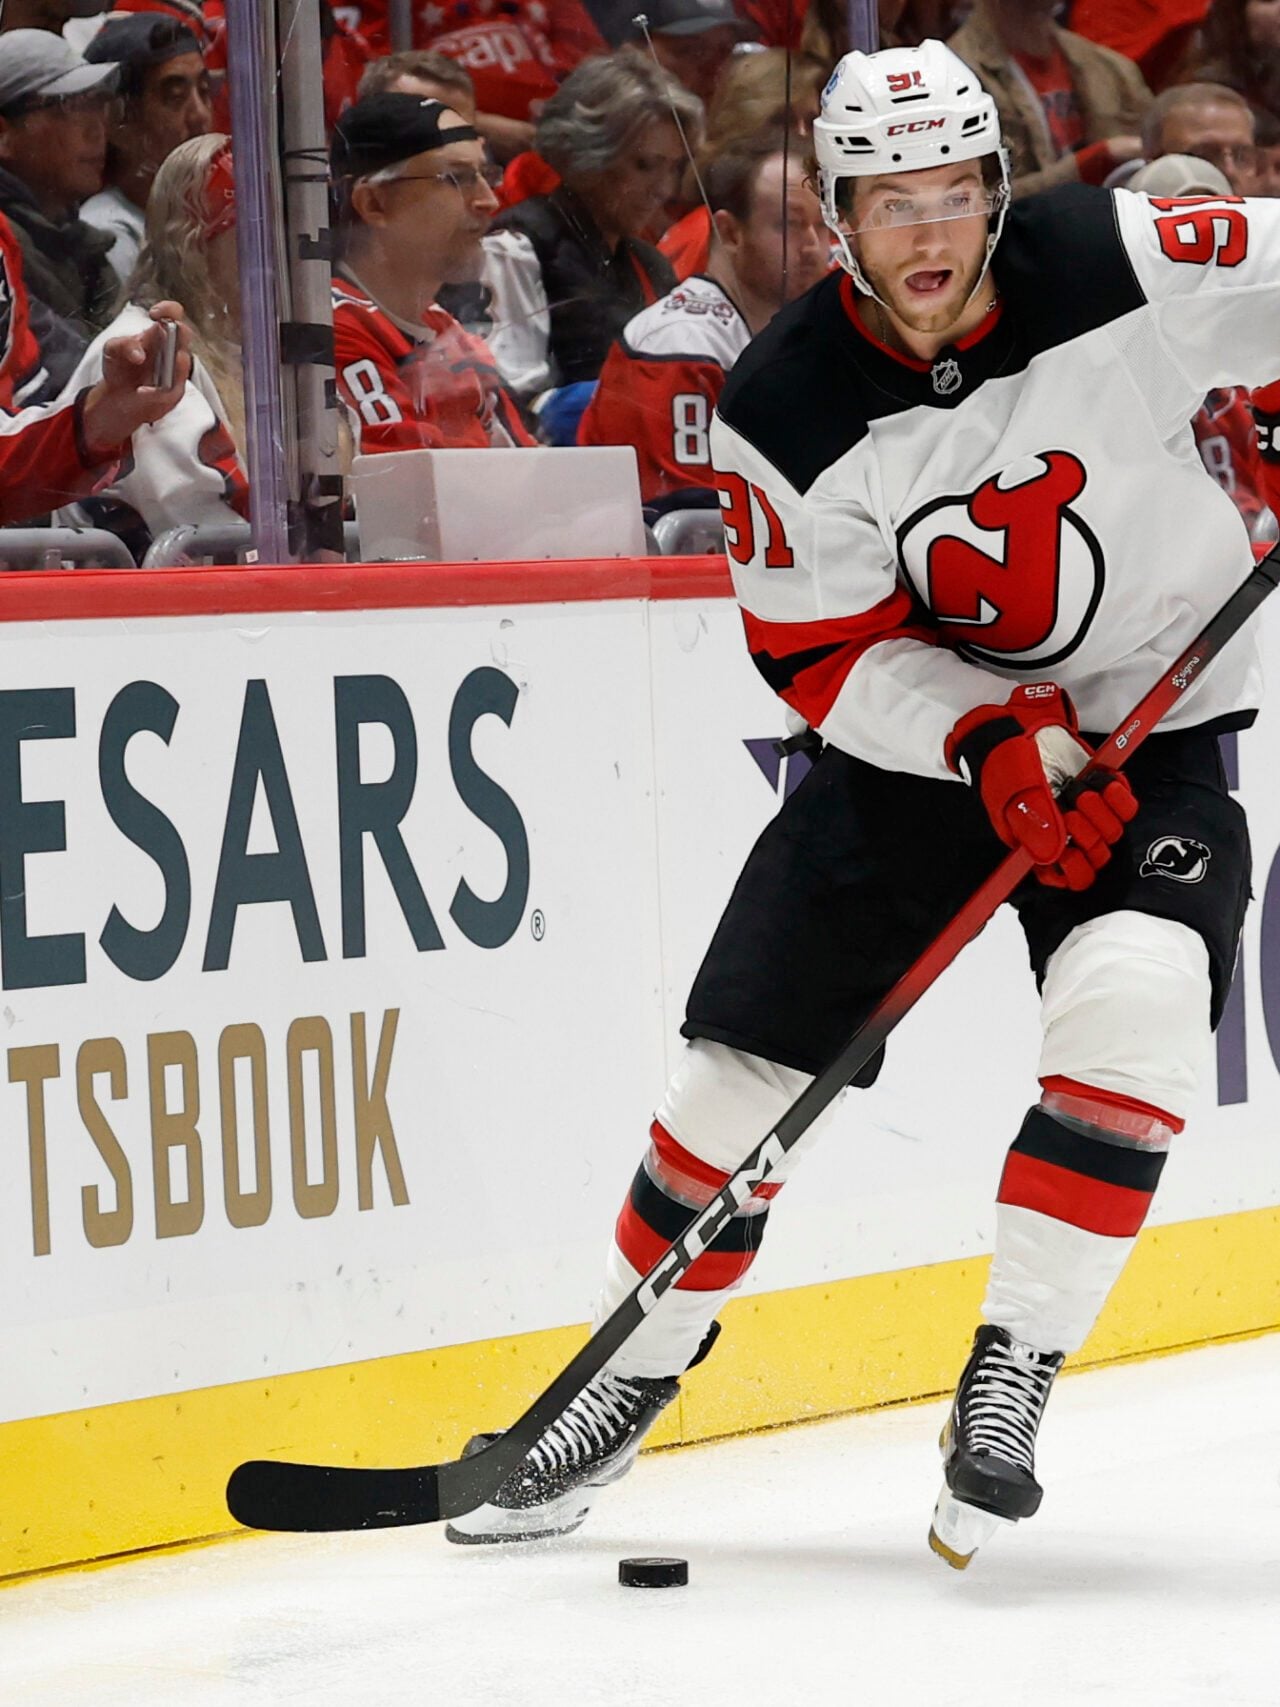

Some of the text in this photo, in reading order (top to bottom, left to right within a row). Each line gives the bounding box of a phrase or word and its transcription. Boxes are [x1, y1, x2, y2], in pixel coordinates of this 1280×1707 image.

[887, 117, 946, 137] CCM
[673, 392, 710, 465] 8
[713, 470, 794, 569] 91
[7, 1007, 411, 1257] TSBOOK
[636, 1131, 787, 1315] CCM
